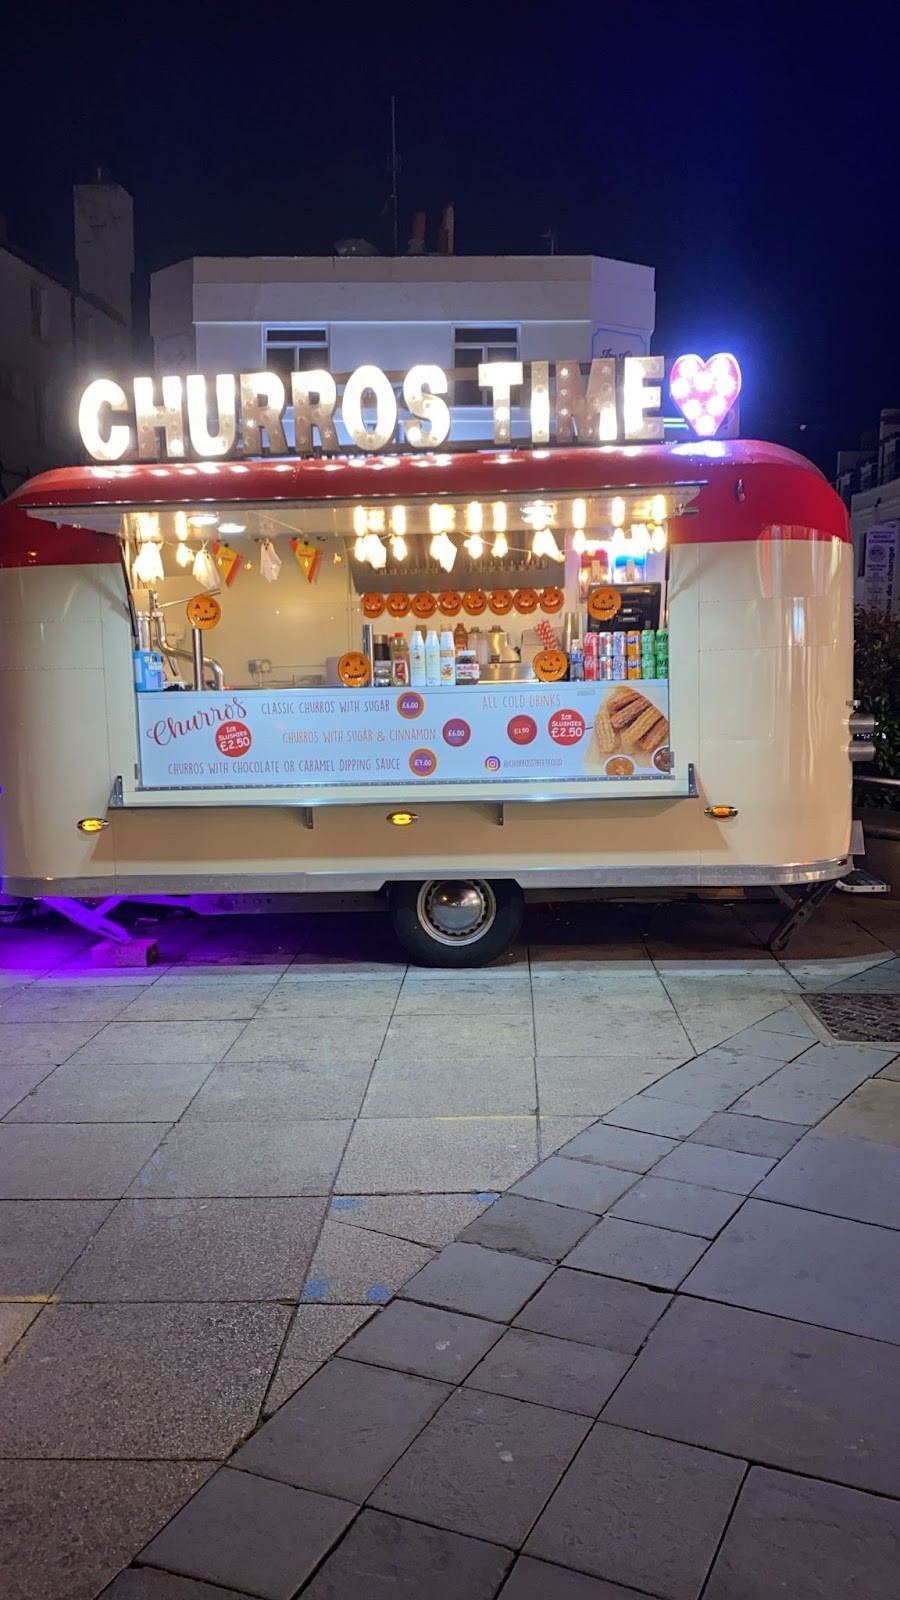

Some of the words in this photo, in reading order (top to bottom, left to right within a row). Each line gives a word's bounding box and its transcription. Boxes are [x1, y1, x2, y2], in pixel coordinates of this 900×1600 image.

[78, 364, 451, 461] CHURROS
[478, 355, 666, 444] TIME
[261, 702, 294, 715] CLASSIC
[299, 701, 335, 714] CHURROS
[340, 700, 360, 712] WITH
[364, 699, 390, 712] SUGAR
[482, 696, 498, 709] ALL
[502, 695, 525, 708] COLD
[530, 694, 561, 708] DRINKS
[147, 697, 248, 746] Churros
[218, 730, 247, 741] SLUSHIES
[282, 731, 318, 743] CHURROS
[323, 730, 343, 742] WITH
[347, 729, 372, 742] SUGAR
[377, 731, 386, 742] &
[388, 728, 436, 741] CINNAMON
[551, 727, 582, 738] £2.50
[220, 738, 250, 752] £2.50
[168, 764, 204, 775] CHURROS
[208, 762, 228, 774] WITH
[232, 761, 280, 773] CHOCOLATE
[284, 760, 294, 772] OR
[299, 759, 335, 772] CARAMEL
[339, 759, 371, 771] DIPPING
[375, 758, 401, 770] SAUCE
